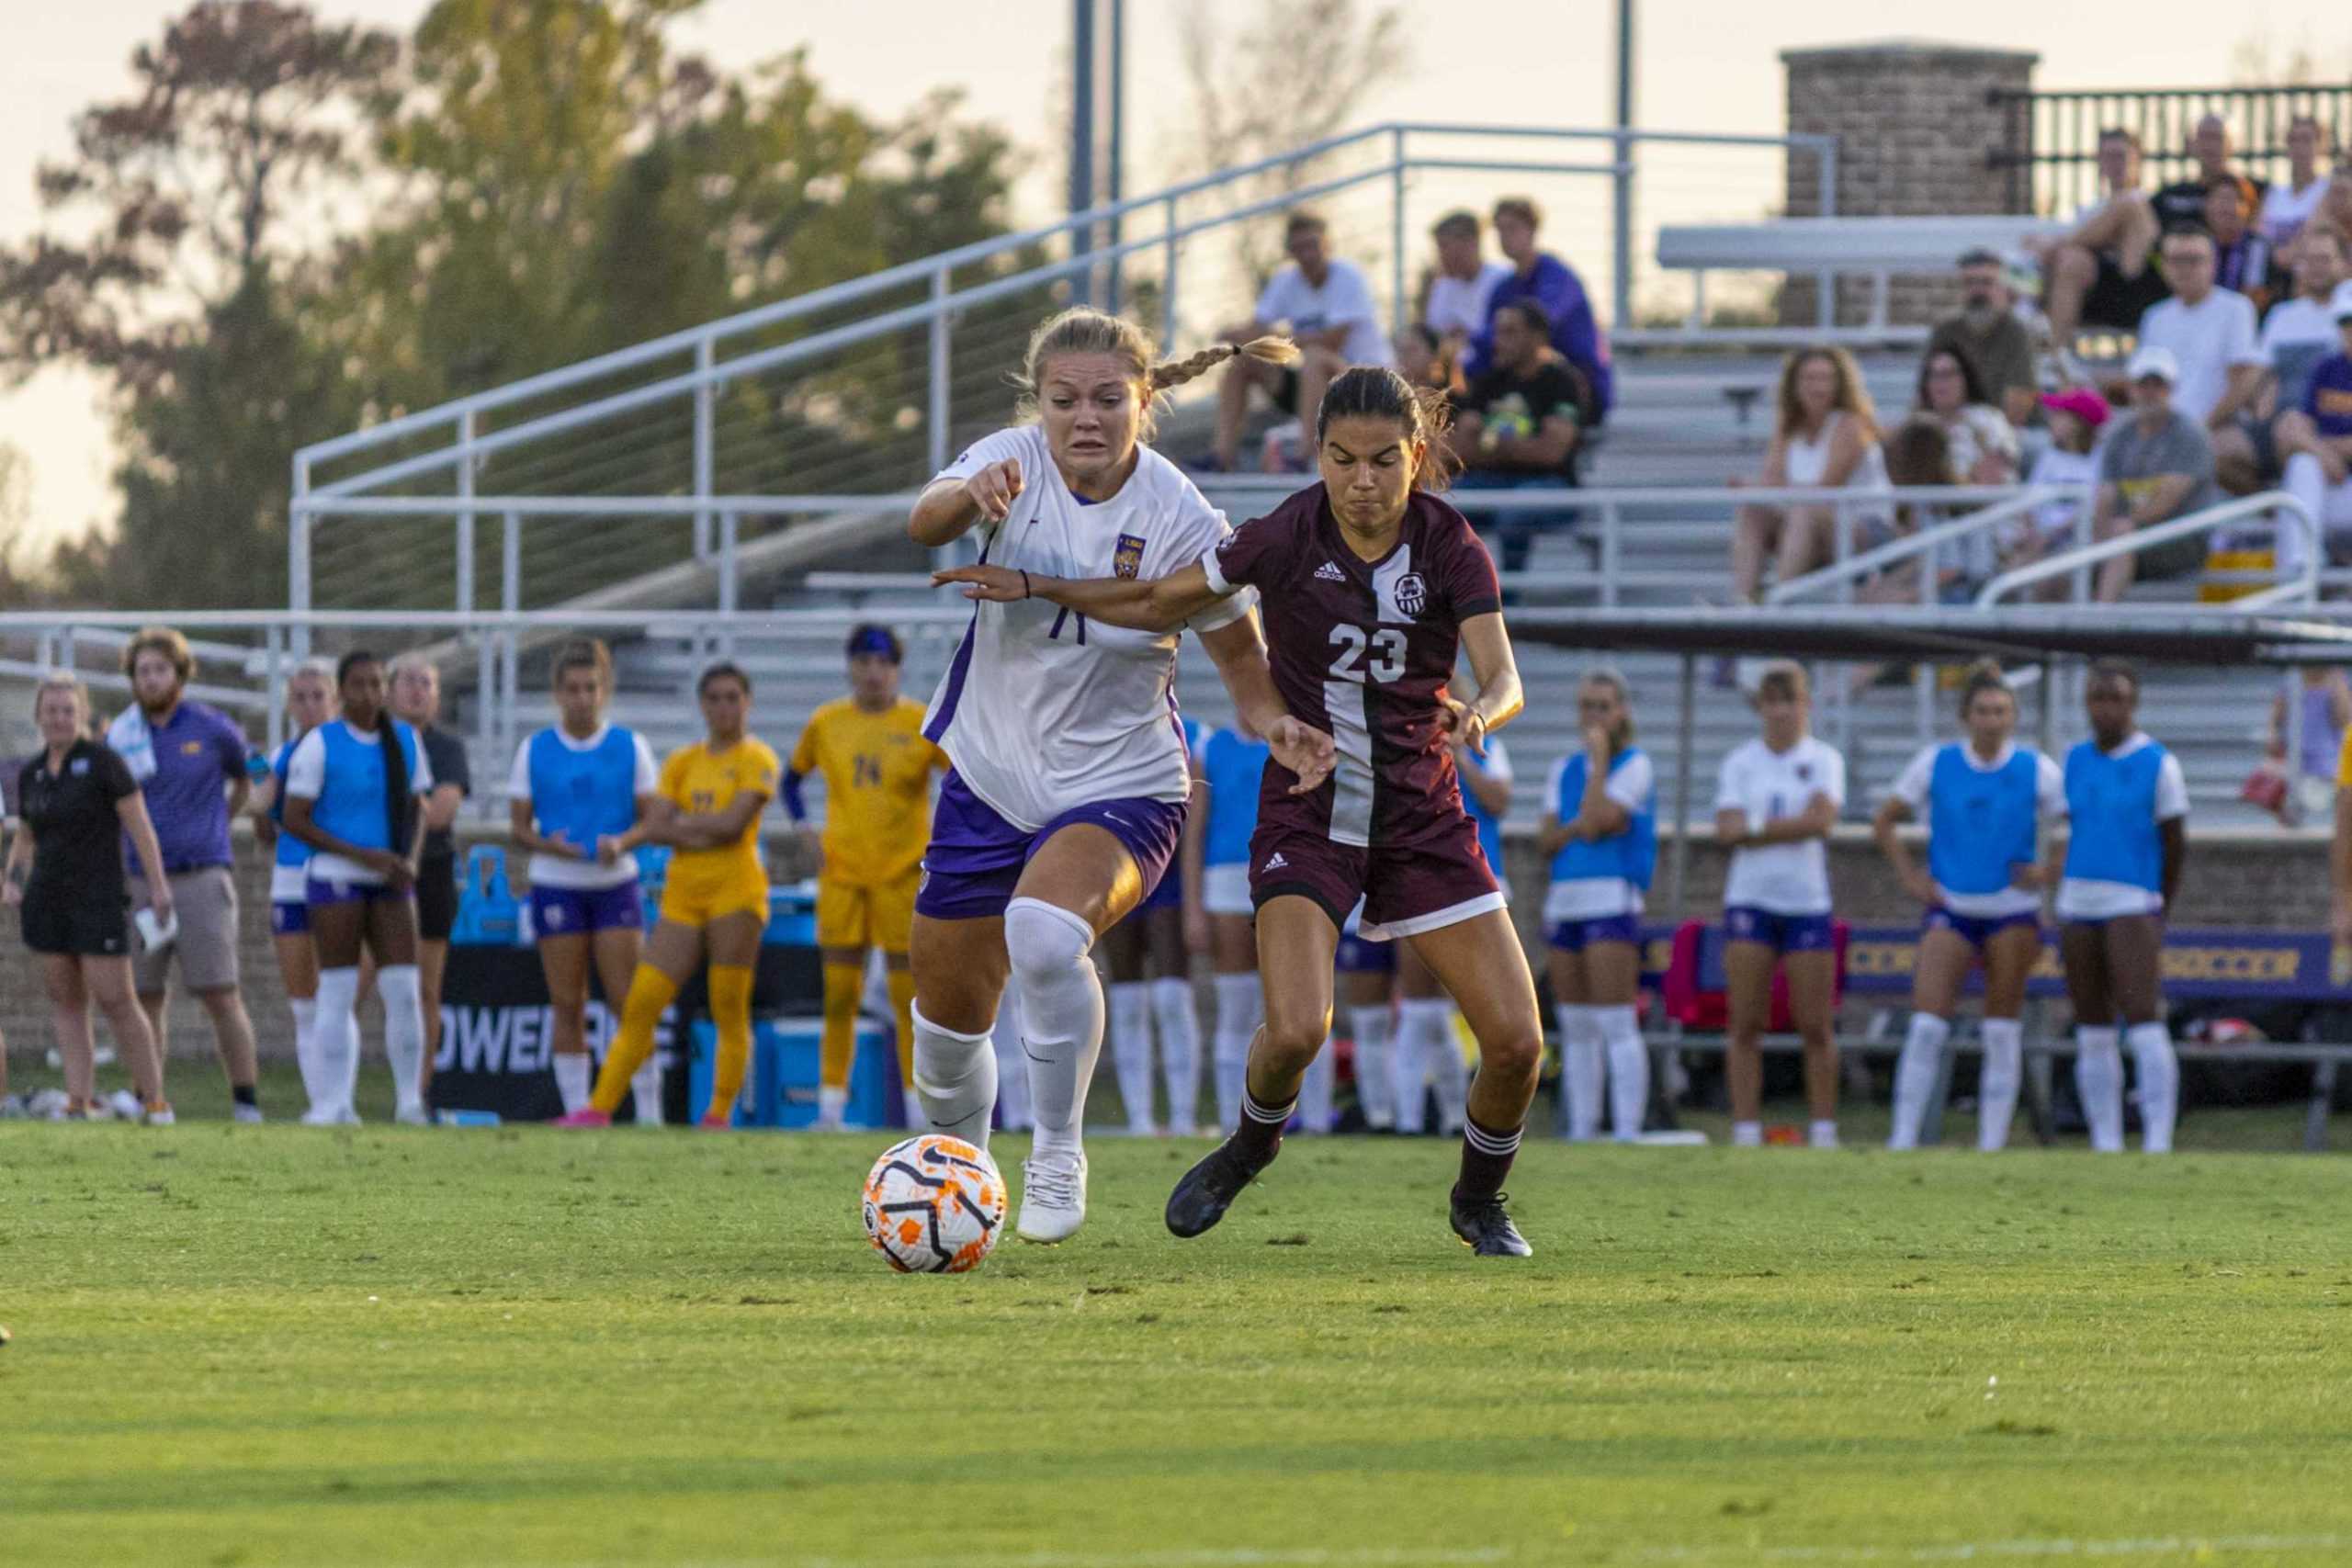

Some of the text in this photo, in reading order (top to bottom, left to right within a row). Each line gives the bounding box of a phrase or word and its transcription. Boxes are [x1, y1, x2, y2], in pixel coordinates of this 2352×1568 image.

[1314, 570, 1346, 582] adidas
[1329, 623, 1408, 683] 23
[2159, 948, 2300, 979] SOCCER
